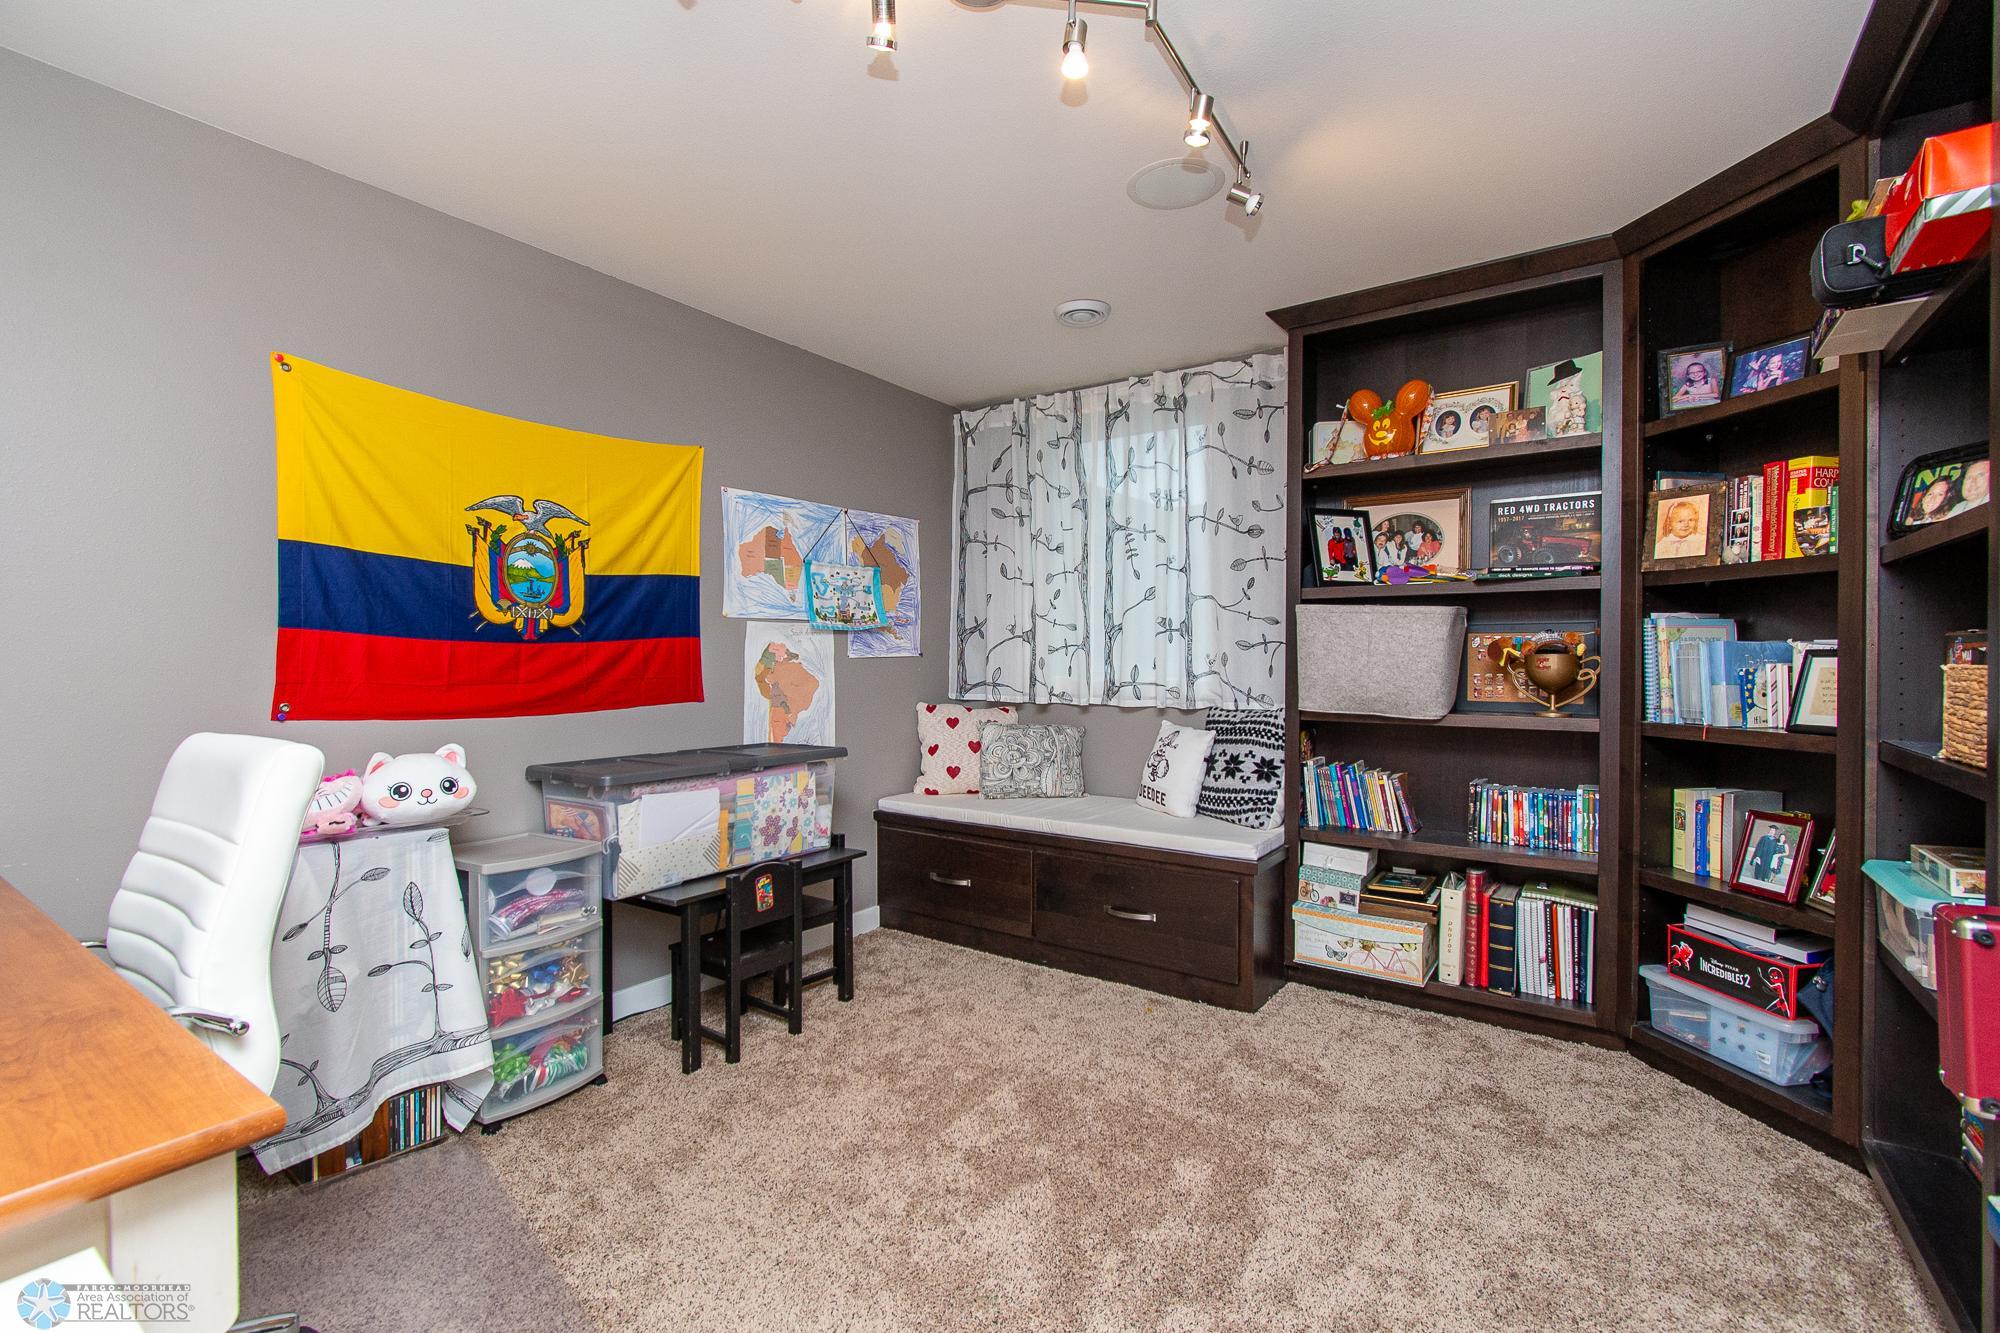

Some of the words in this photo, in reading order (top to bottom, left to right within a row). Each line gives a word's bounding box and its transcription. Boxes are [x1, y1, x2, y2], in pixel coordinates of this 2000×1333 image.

[1816, 468, 1839, 477] HARP
[1497, 507, 1516, 516] RED
[1519, 504, 1540, 514] 4WD
[1544, 499, 1595, 512] TRACTORS
[1700, 957, 1744, 985] INCREDIBLES
[1744, 973, 1751, 989] 2
